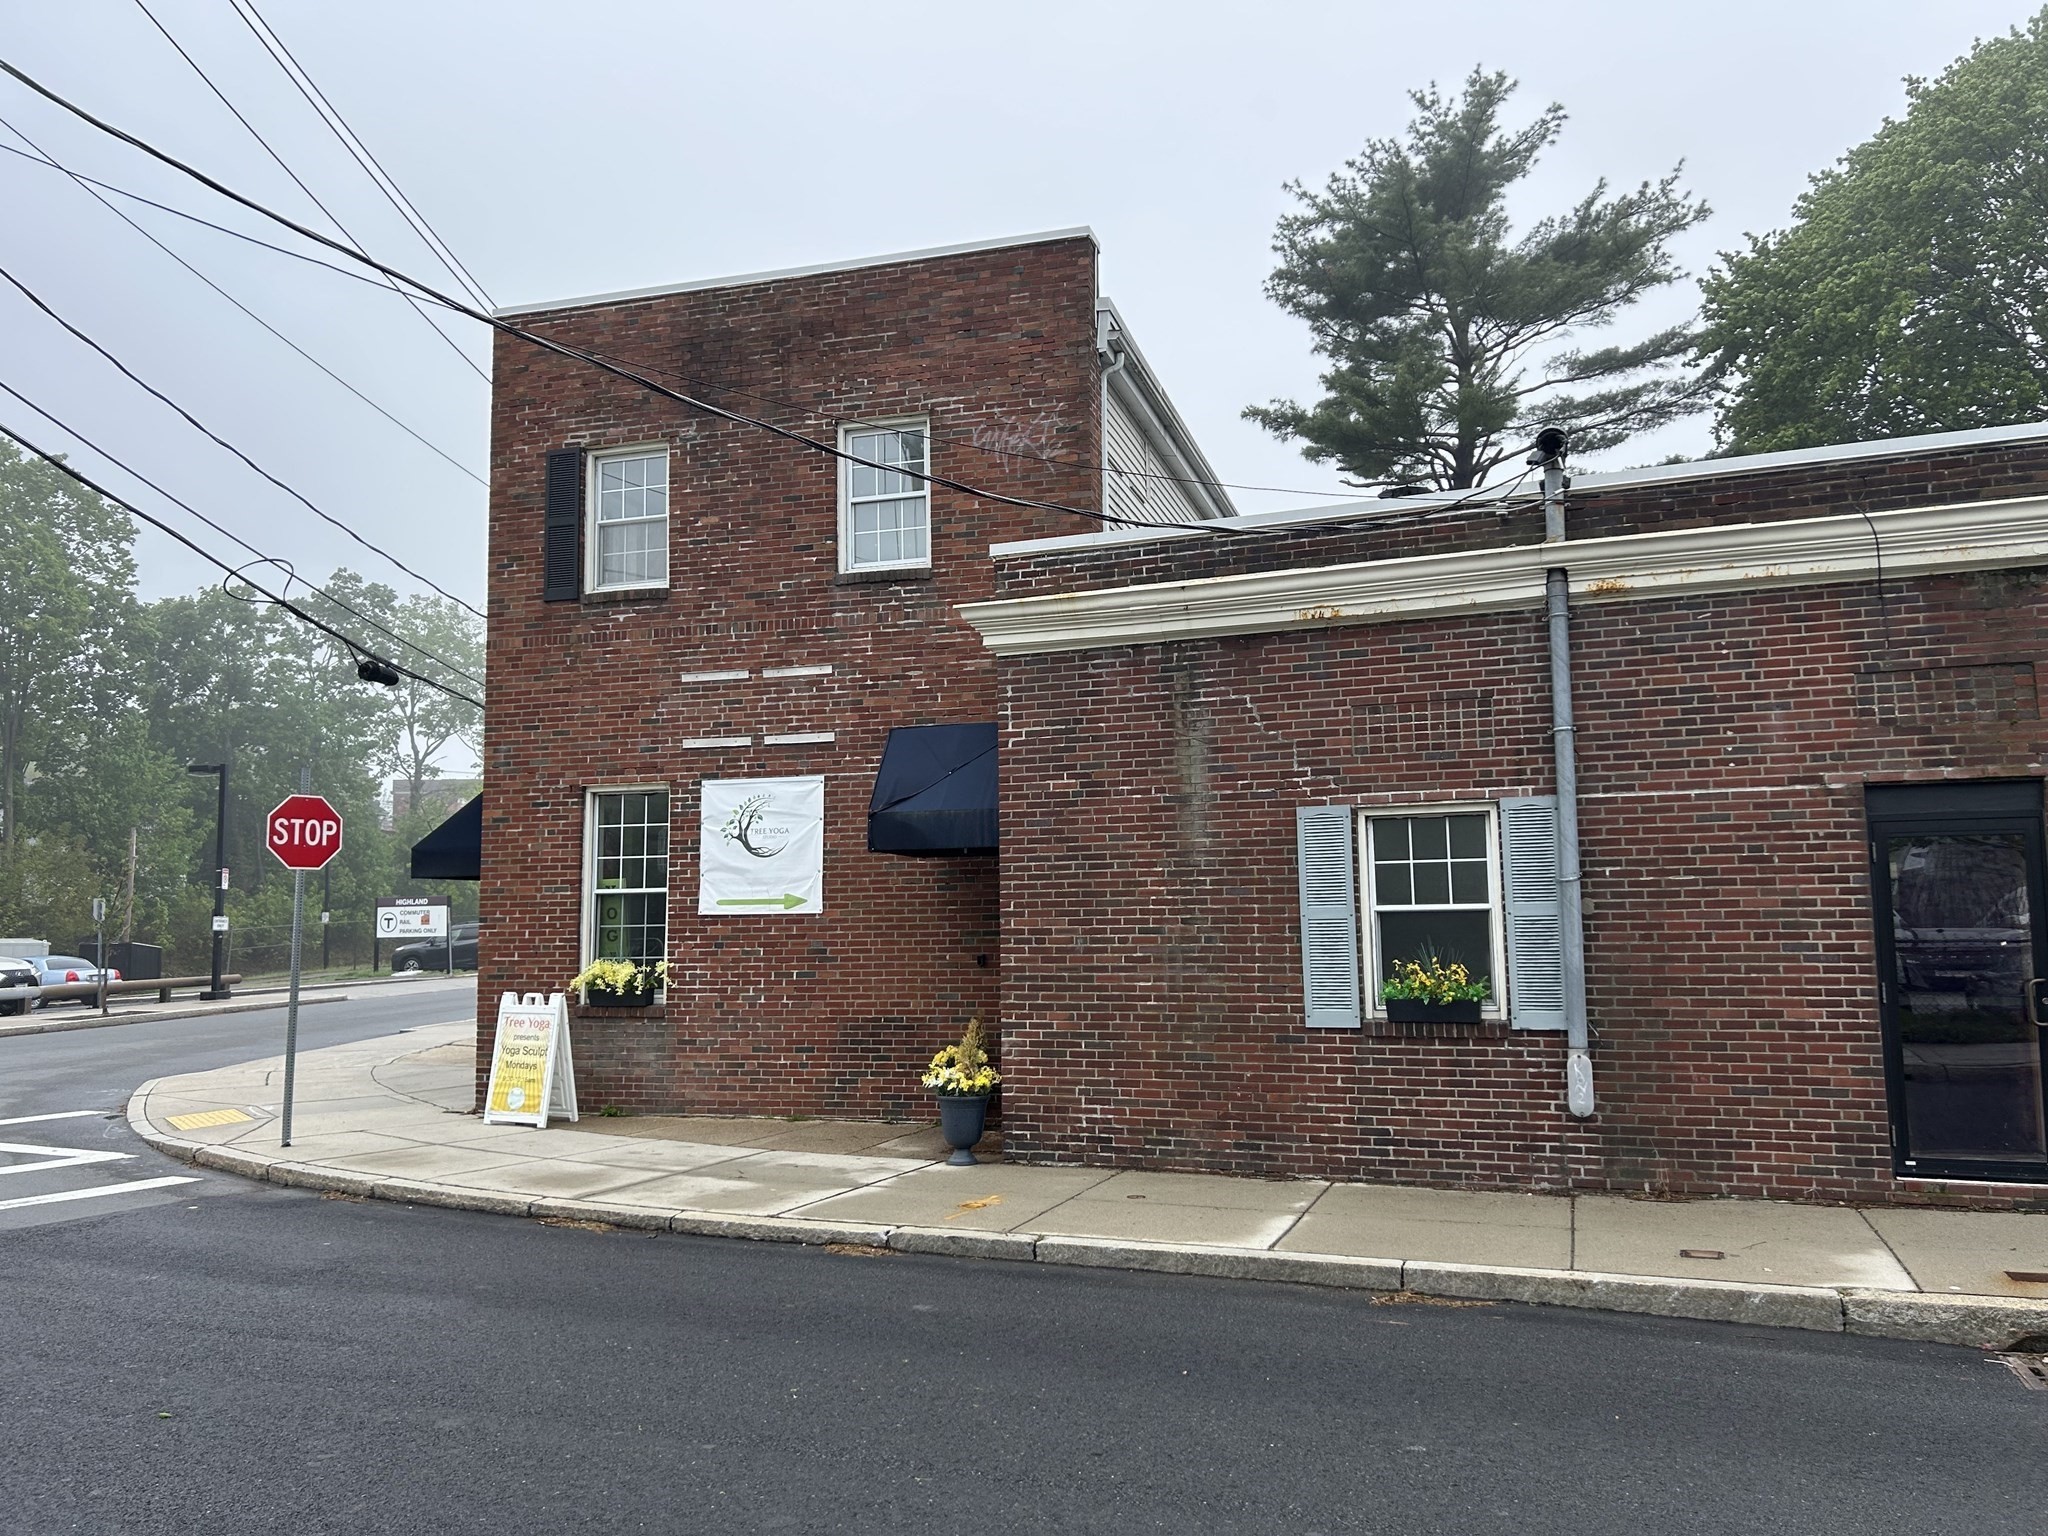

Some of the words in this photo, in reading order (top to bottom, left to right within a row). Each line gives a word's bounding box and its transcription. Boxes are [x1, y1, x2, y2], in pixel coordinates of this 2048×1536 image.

[272, 817, 337, 846] STOP
[505, 1016, 525, 1028] Tree
[528, 1017, 550, 1031] Yoga
[502, 1045, 520, 1057] Yoga
[522, 1046, 548, 1057] Sculpt
[506, 1061, 537, 1071] Mondays
